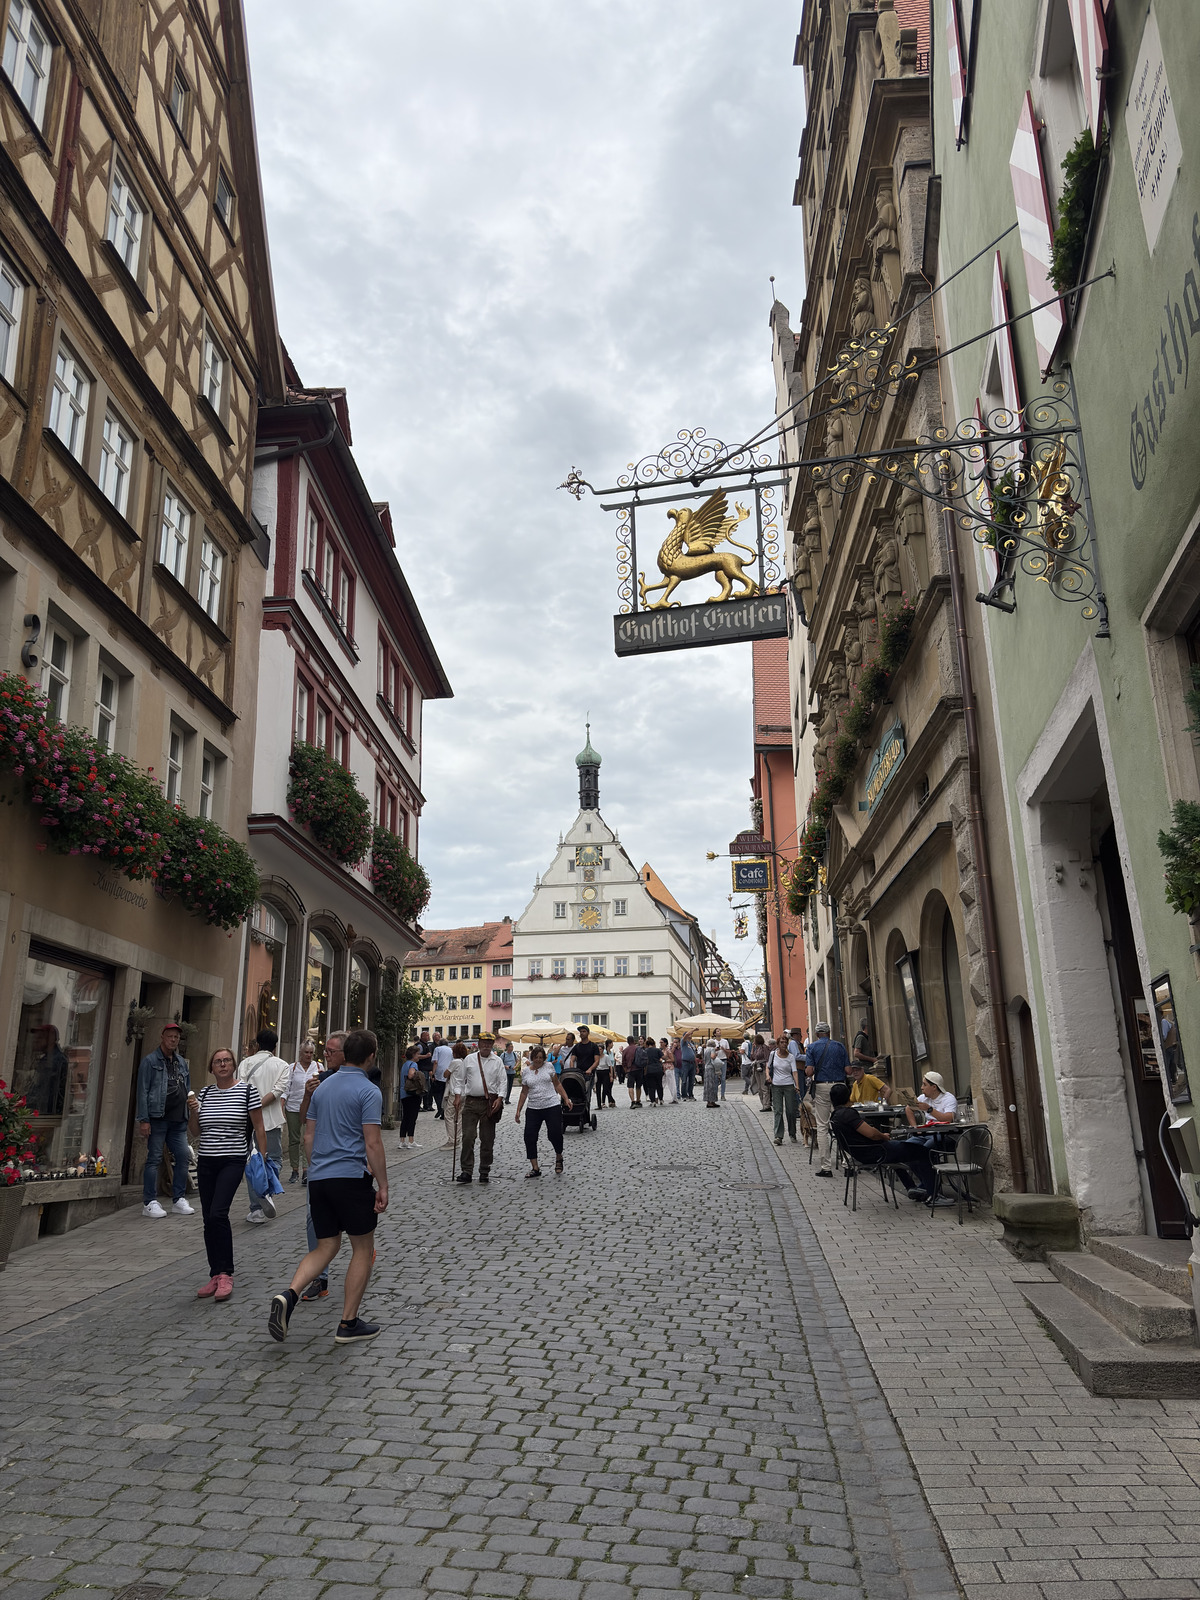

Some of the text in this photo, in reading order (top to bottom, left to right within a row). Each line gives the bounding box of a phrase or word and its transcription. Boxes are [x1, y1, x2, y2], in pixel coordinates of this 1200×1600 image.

[618, 601, 782, 643] Gasthof Greifen
[731, 844, 770, 852] RESTAURANT
